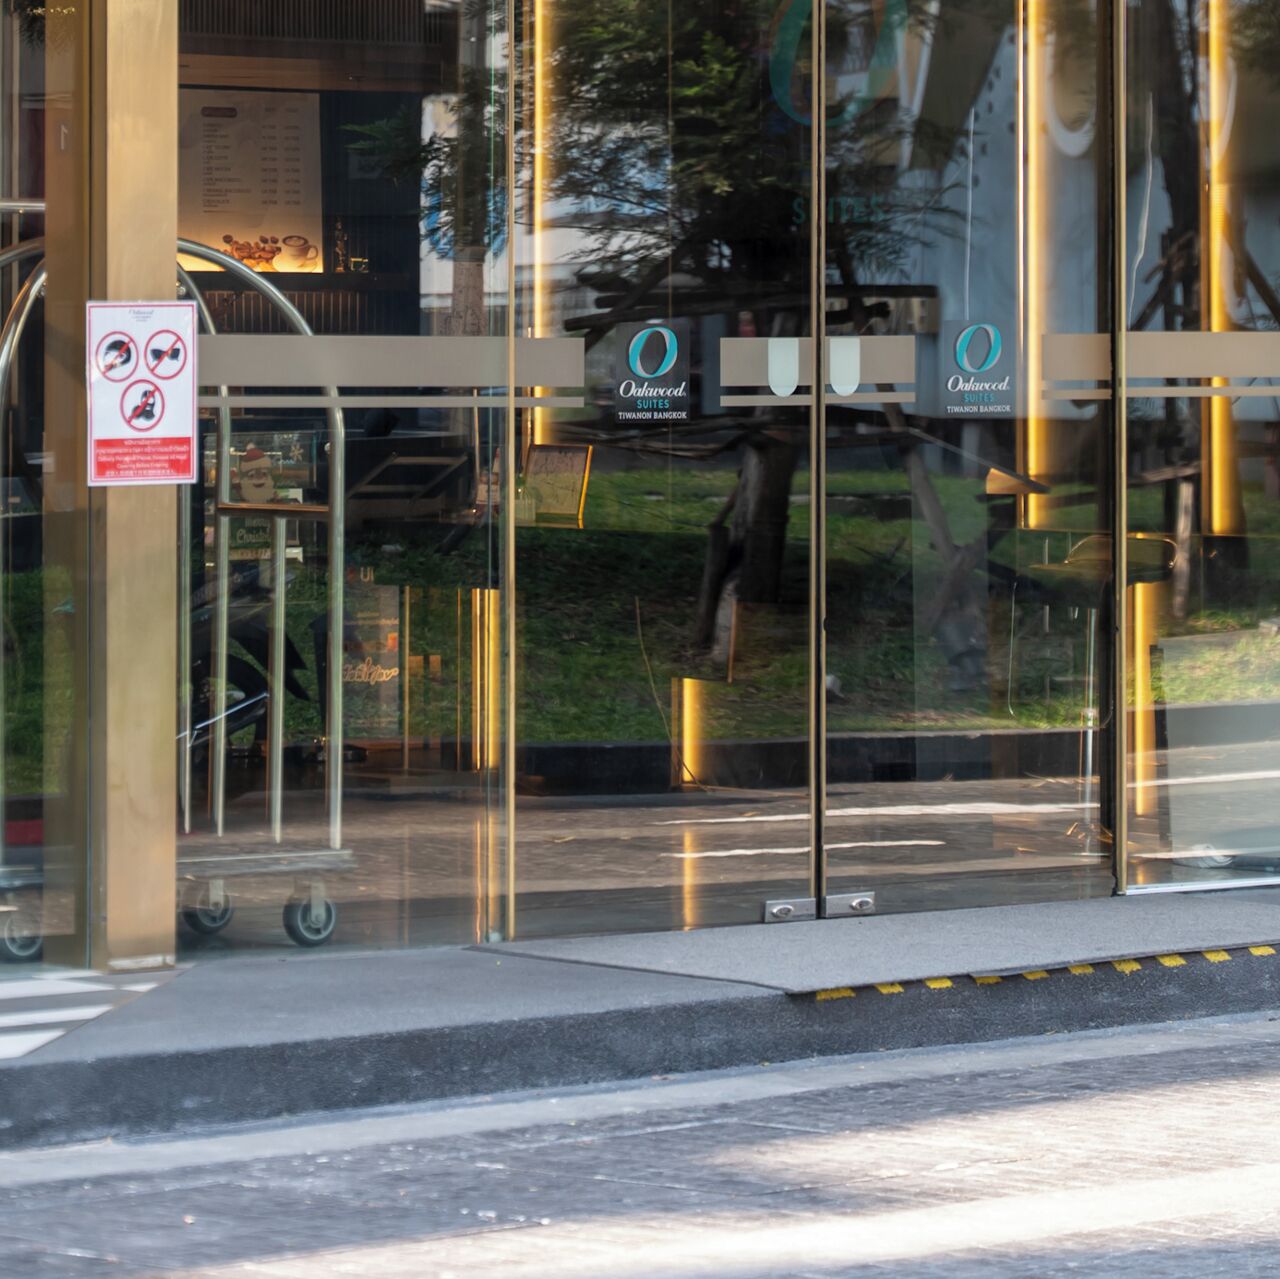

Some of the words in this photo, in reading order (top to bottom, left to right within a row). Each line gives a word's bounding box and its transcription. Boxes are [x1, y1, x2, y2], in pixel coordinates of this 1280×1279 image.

[792, 195, 886, 225] SITES
[964, 393, 994, 402] SUITES
[637, 400, 670, 409] SUITES
[653, 411, 687, 419] BANGKOK
